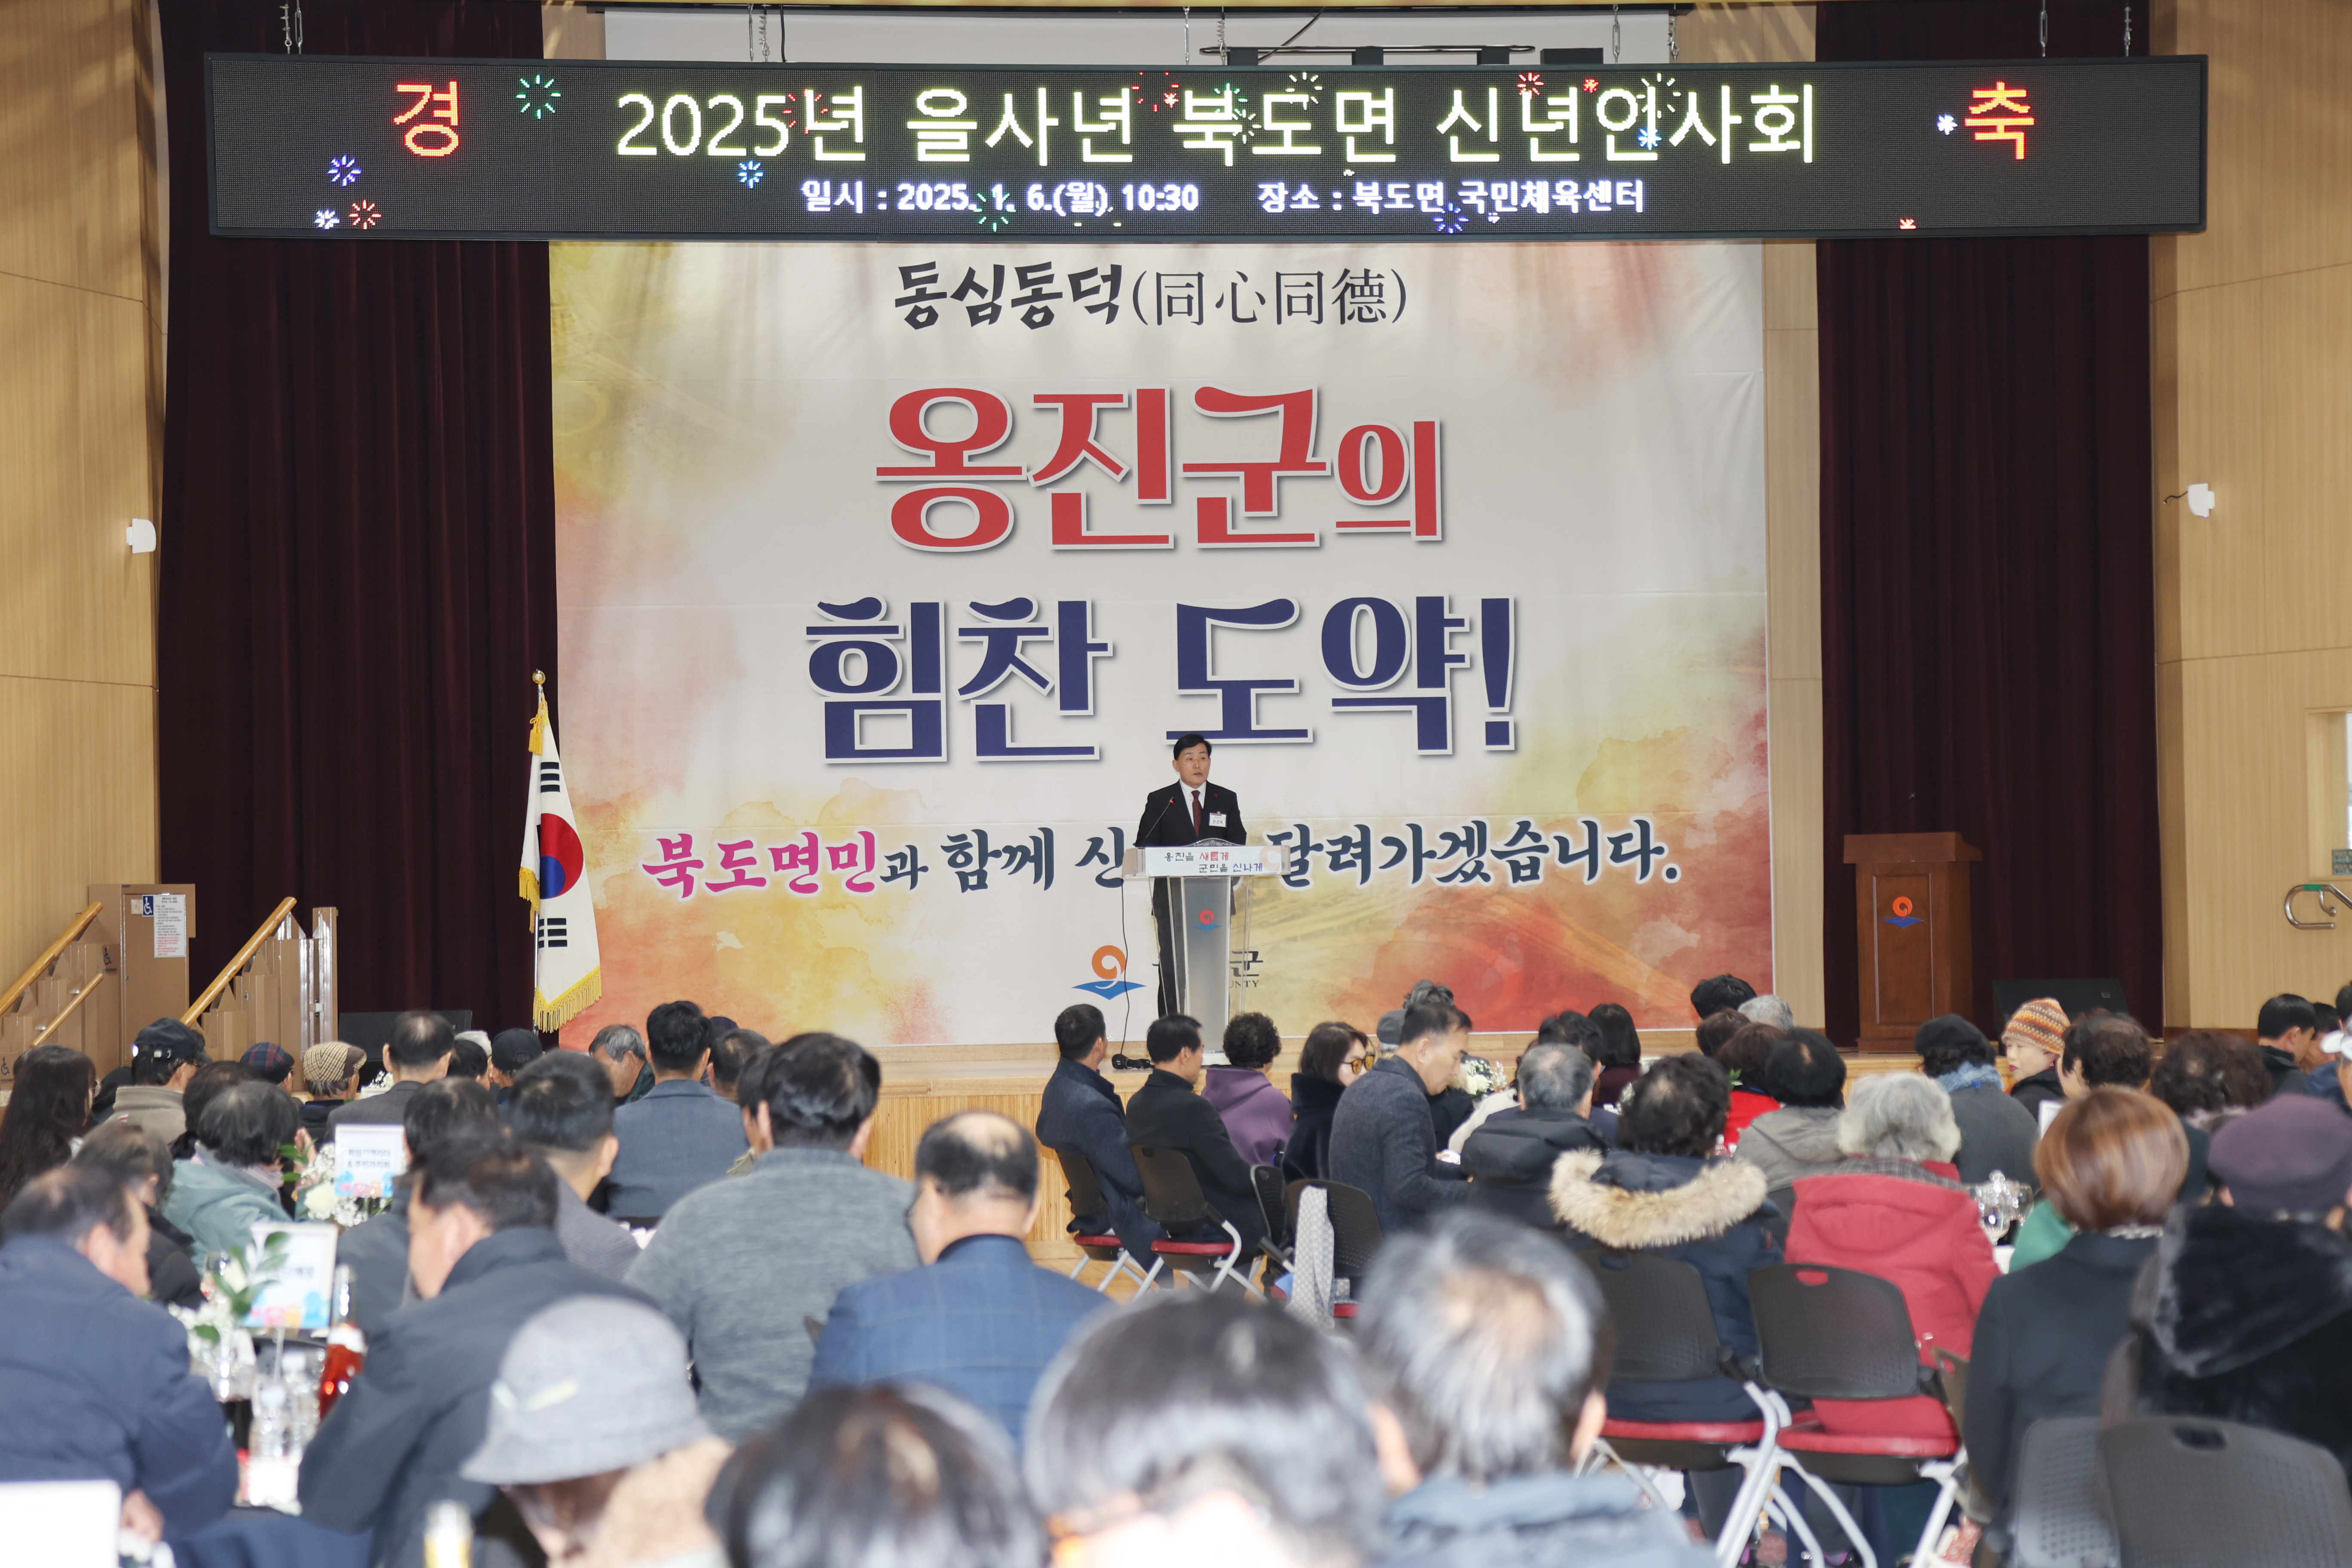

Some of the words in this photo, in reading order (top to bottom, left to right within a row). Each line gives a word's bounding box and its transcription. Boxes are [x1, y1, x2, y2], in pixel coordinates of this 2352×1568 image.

[393, 80, 459, 157] 경
[618, 86, 865, 162] 2025년
[907, 86, 1133, 166] 을사년
[1173, 85, 1396, 166] 북도면
[1436, 83, 1813, 164] 신년인사회
[1964, 81, 2035, 159] 축
[801, 181, 863, 213] 일시
[878, 191, 887, 210] :
[897, 184, 977, 212] 2025.
[1027, 182, 1108, 217] 6.(월)
[1122, 184, 1199, 211] 10:30
[1258, 182, 1321, 212] 장소
[1332, 192, 1342, 210] :
[1353, 181, 1445, 214] 북도면
[1458, 180, 1643, 213] 국민체육센터
[895, 261, 1406, 329] 동심동덕(同心同德)
[876, 386, 1437, 548] 옹진군의
[806, 597, 1108, 759] 힘찬
[1166, 596, 1514, 750] 도약!
[643, 831, 929, 898] 북도면민과
[941, 827, 1054, 893] 함께
[1266, 820, 1678, 887] 달려가겠습니다.
[1164, 852, 1194, 862] 옹진을
[1199, 851, 1229, 861] 새롭게
[1199, 864, 1228, 873] 군민을
[1233, 863, 1263, 872] 신나게
